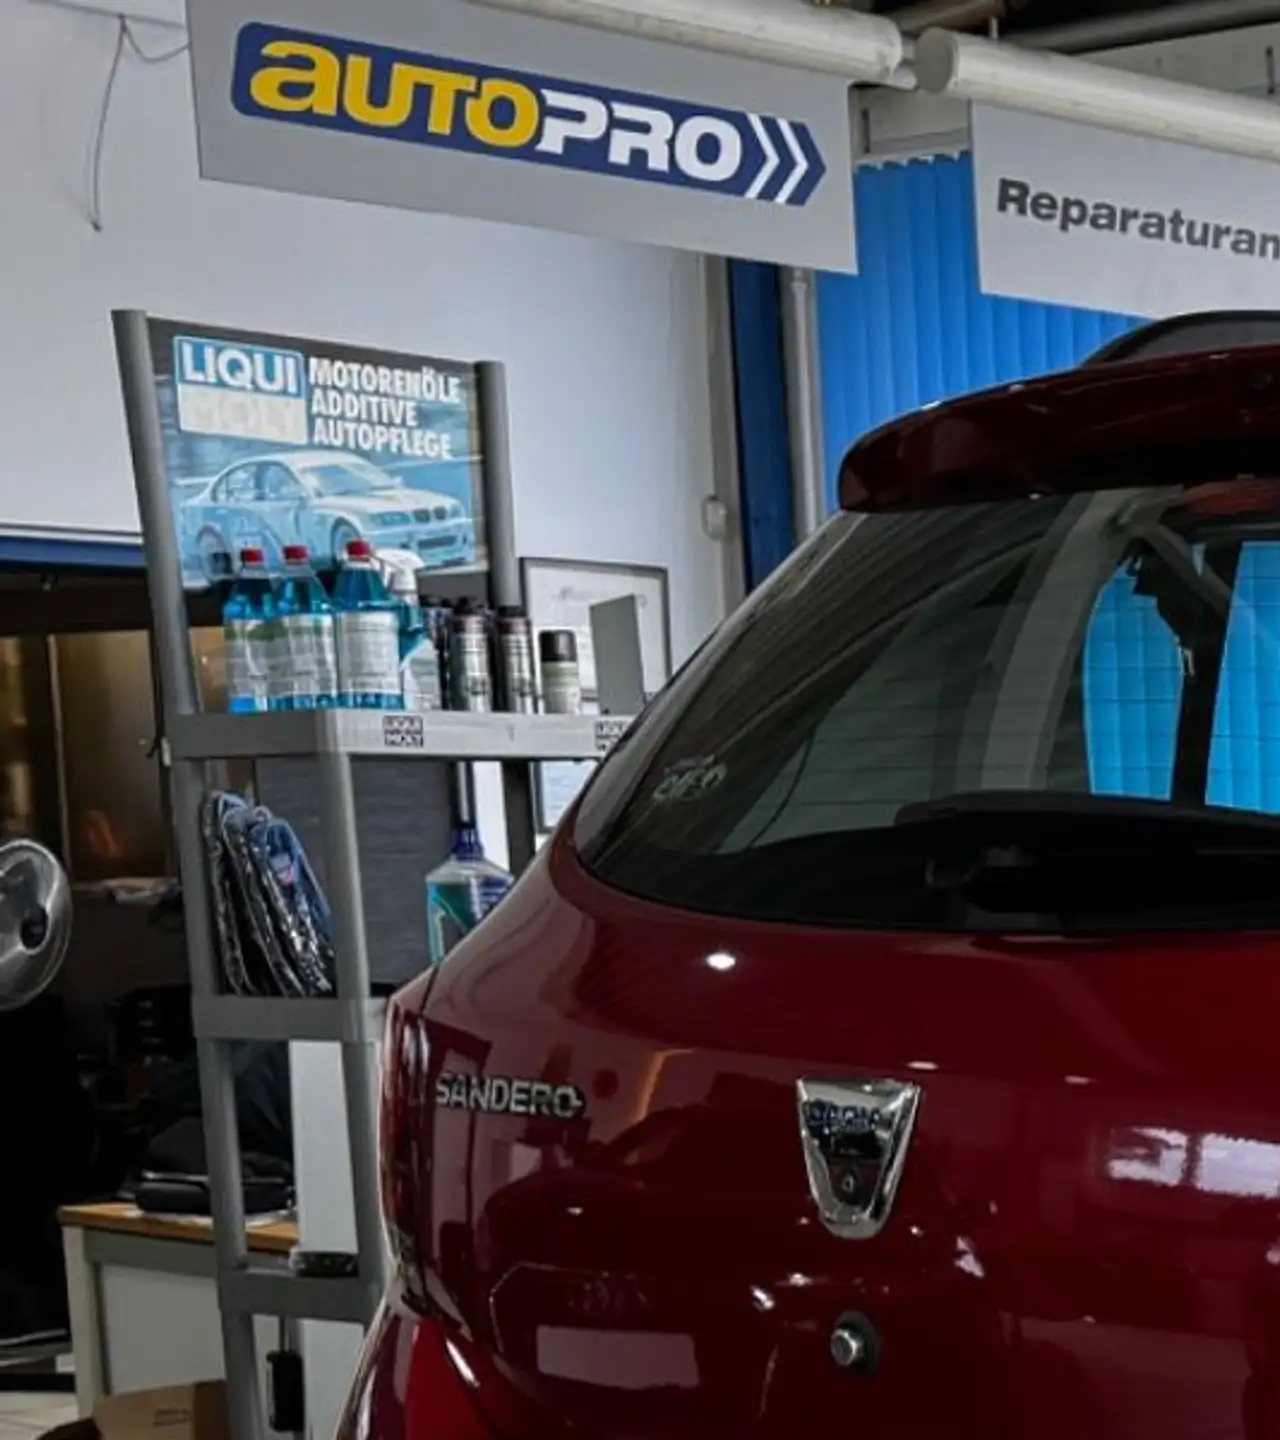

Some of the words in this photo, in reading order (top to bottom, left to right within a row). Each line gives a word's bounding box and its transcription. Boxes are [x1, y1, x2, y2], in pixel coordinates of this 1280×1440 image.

[182, 342, 298, 393] LIQUI
[309, 356, 462, 403] MOTORENÖLE
[311, 389, 419, 426] ADDITIVE
[313, 420, 453, 460] AUTOPFLEGE
[435, 1071, 579, 1119] SANDERO
